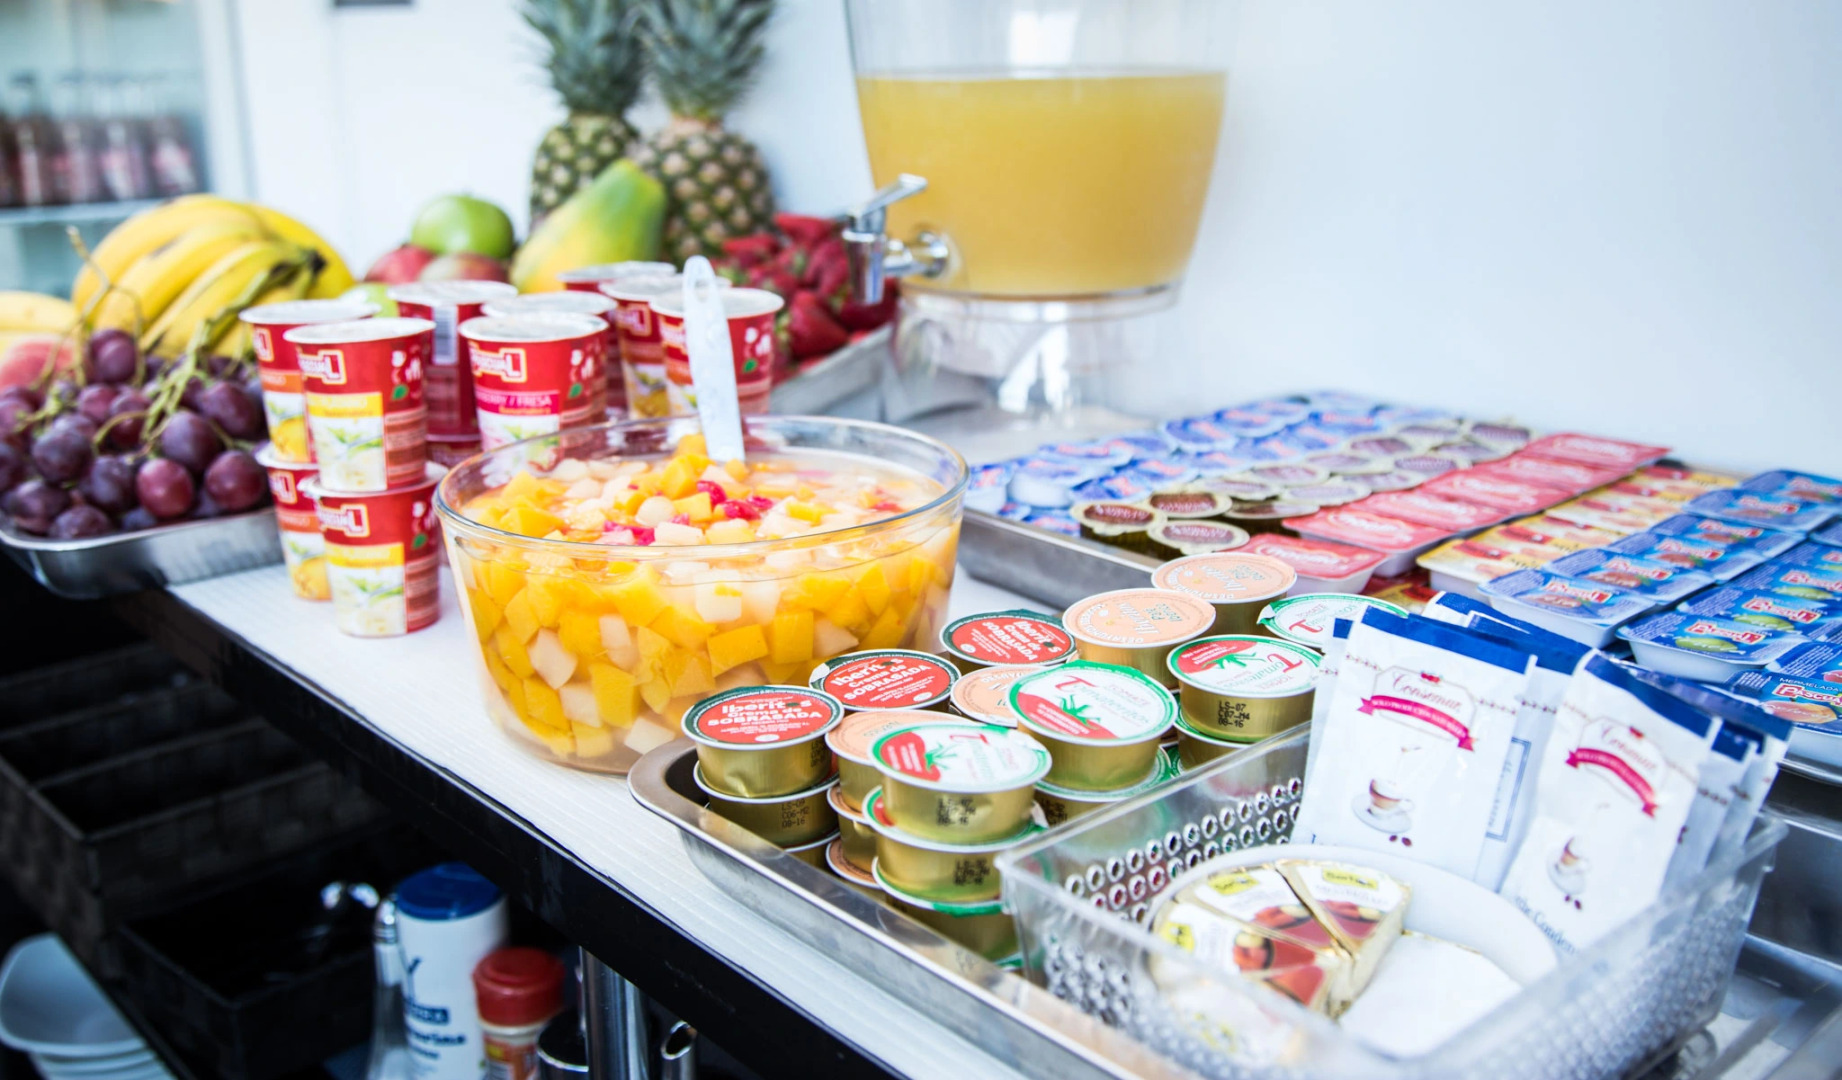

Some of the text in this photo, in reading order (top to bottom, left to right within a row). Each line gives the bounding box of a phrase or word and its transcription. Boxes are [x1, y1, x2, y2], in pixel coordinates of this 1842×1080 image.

[982, 621, 1039, 661] SOBRASADA
[830, 658, 904, 686] Iberitos
[848, 664, 907, 688] Crema de
[843, 665, 932, 700] SOBRASADA
[1779, 677, 1840, 692] MERMELADA
[721, 699, 813, 714] Iberitos
[727, 706, 803, 719] Crema de
[707, 711, 823, 726] SOBRASADA
